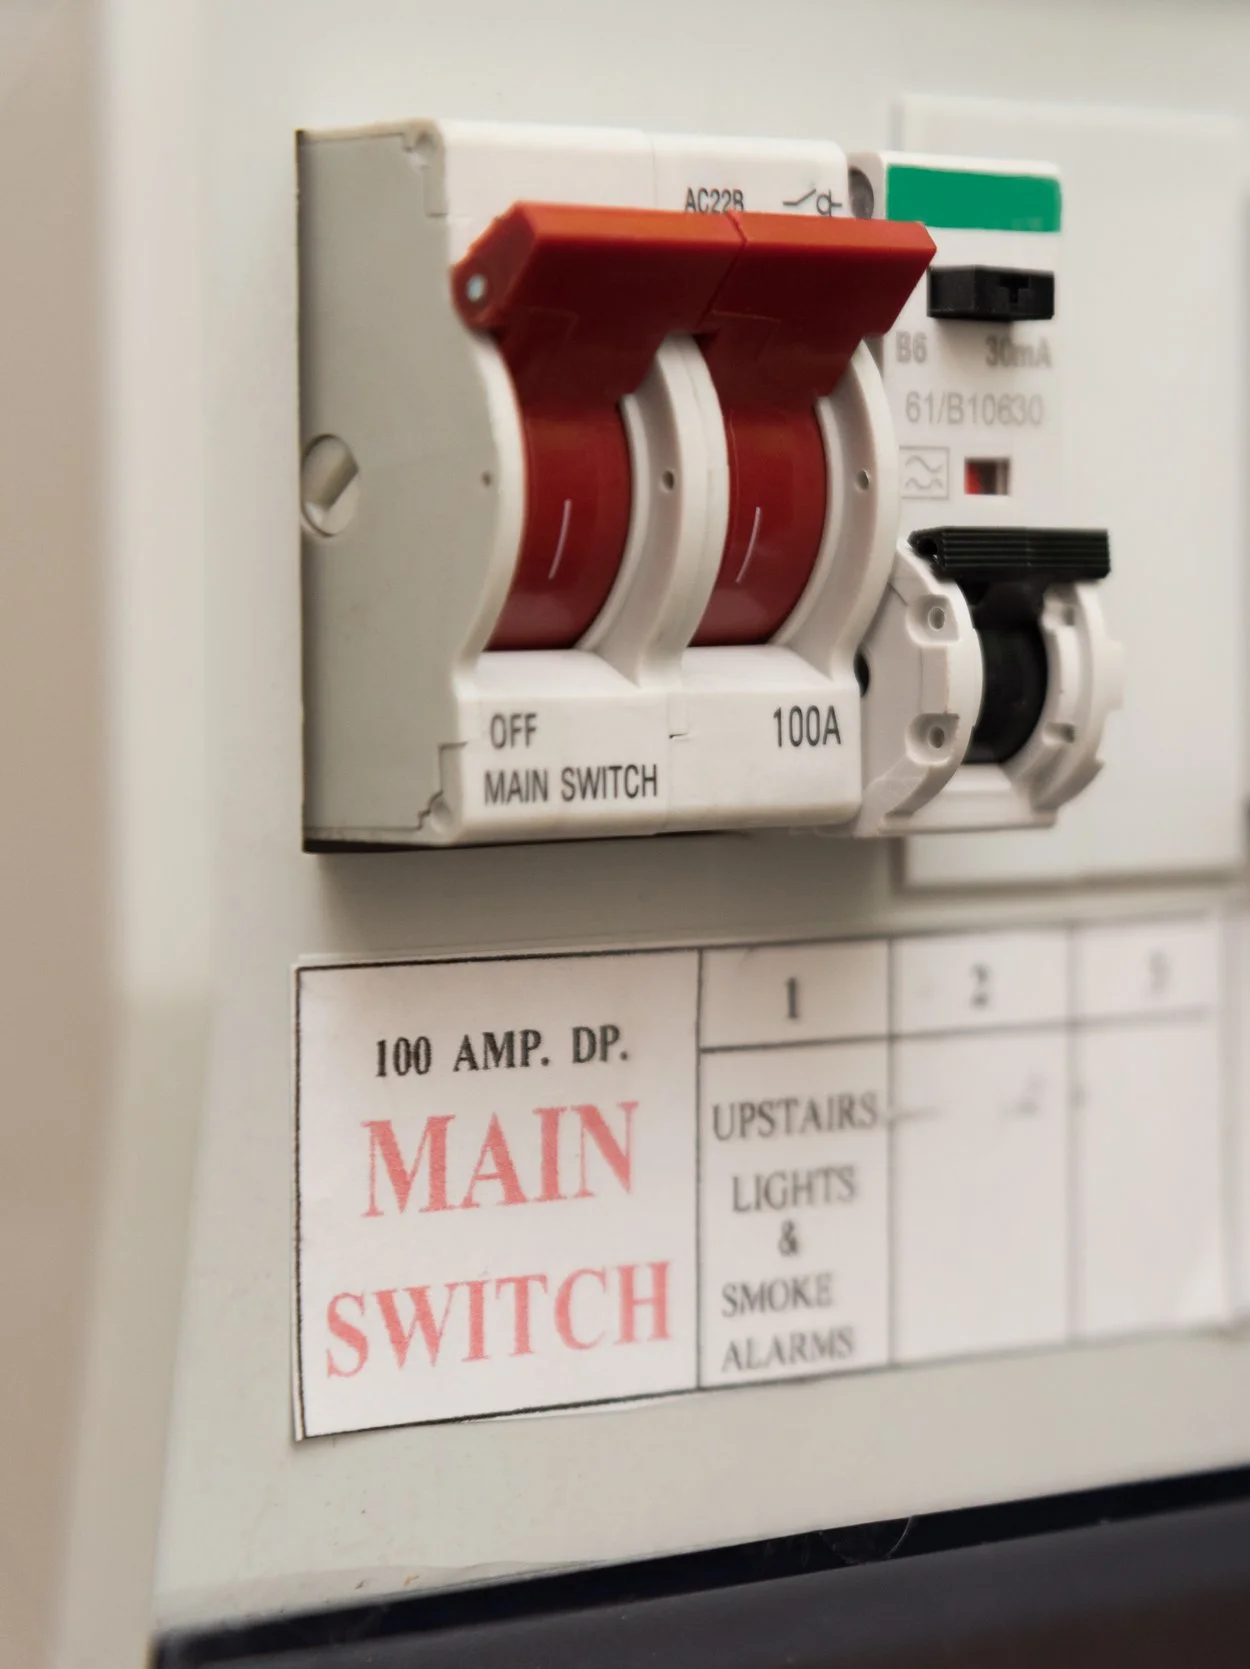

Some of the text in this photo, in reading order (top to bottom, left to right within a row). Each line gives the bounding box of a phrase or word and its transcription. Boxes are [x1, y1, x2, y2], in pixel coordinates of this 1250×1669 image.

[685, 186, 744, 213] AC22B
[895, 330, 1053, 368] B6 30mA
[904, 389, 1044, 427] 61/B10630
[490, 713, 538, 749] OFF
[772, 704, 842, 748] 100A
[484, 763, 658, 806] MAIN SWITCH
[783, 976, 802, 1020] 1
[969, 962, 991, 1009] 2
[374, 1023, 630, 1078] 100 AMP. DP.
[711, 1091, 879, 1142] UPSTAIRS
[360, 1100, 640, 1219] MAIN
[730, 1164, 856, 1213] LIGHTS
[777, 1218, 801, 1258] &
[720, 1272, 834, 1318] SMOKE
[325, 1260, 671, 1379] SWITCH
[720, 1325, 856, 1372] ALARMS
